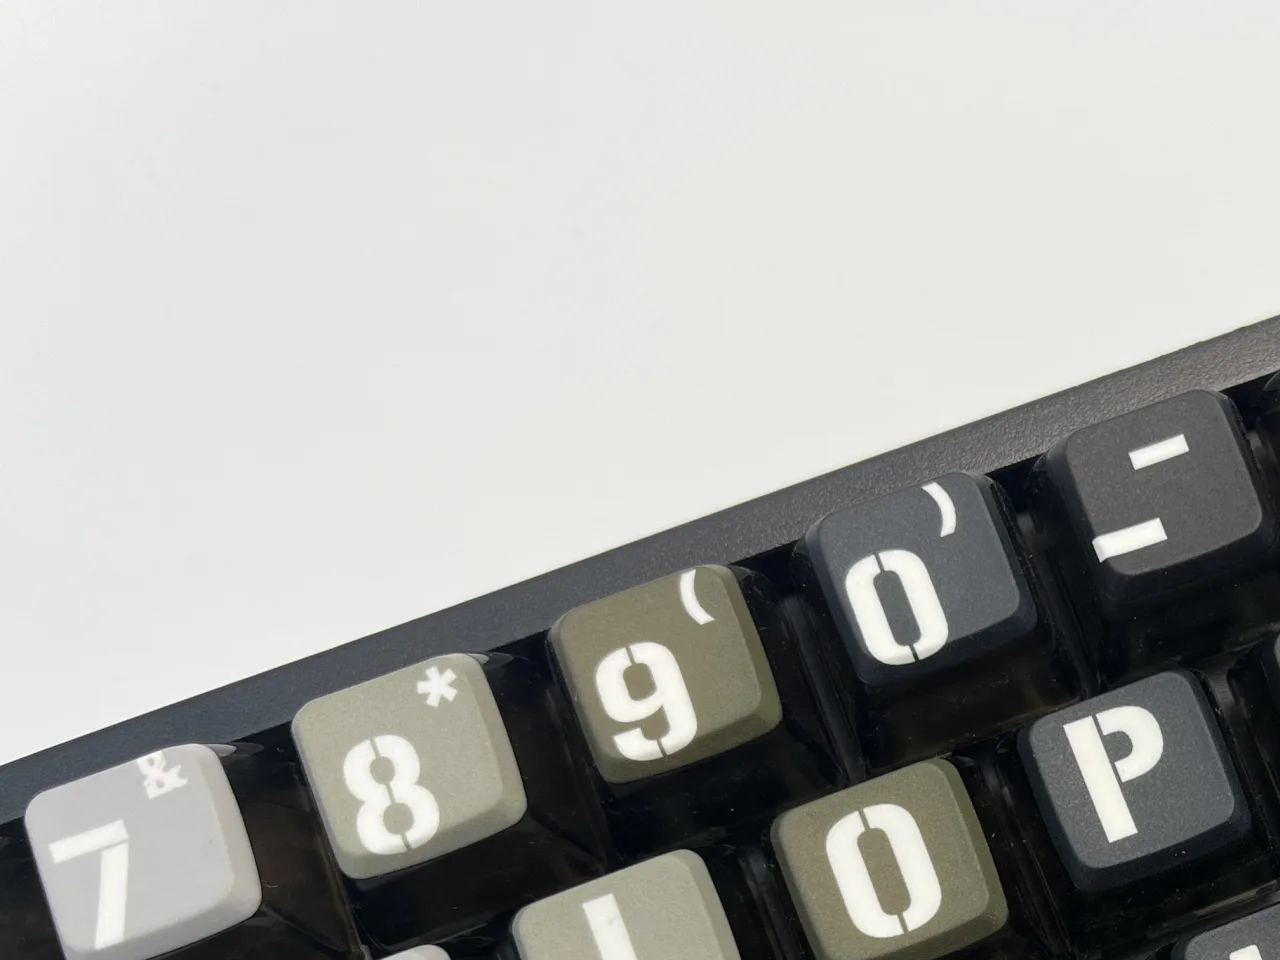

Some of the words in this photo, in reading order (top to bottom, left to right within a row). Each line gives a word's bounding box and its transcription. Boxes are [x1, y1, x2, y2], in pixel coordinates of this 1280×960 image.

[845, 549, 948, 665] 0
[596, 642, 697, 760] 9
[343, 735, 440, 853] 8
[1063, 706, 1163, 843] P
[49, 820, 128, 949] 7
[826, 804, 941, 938] O
